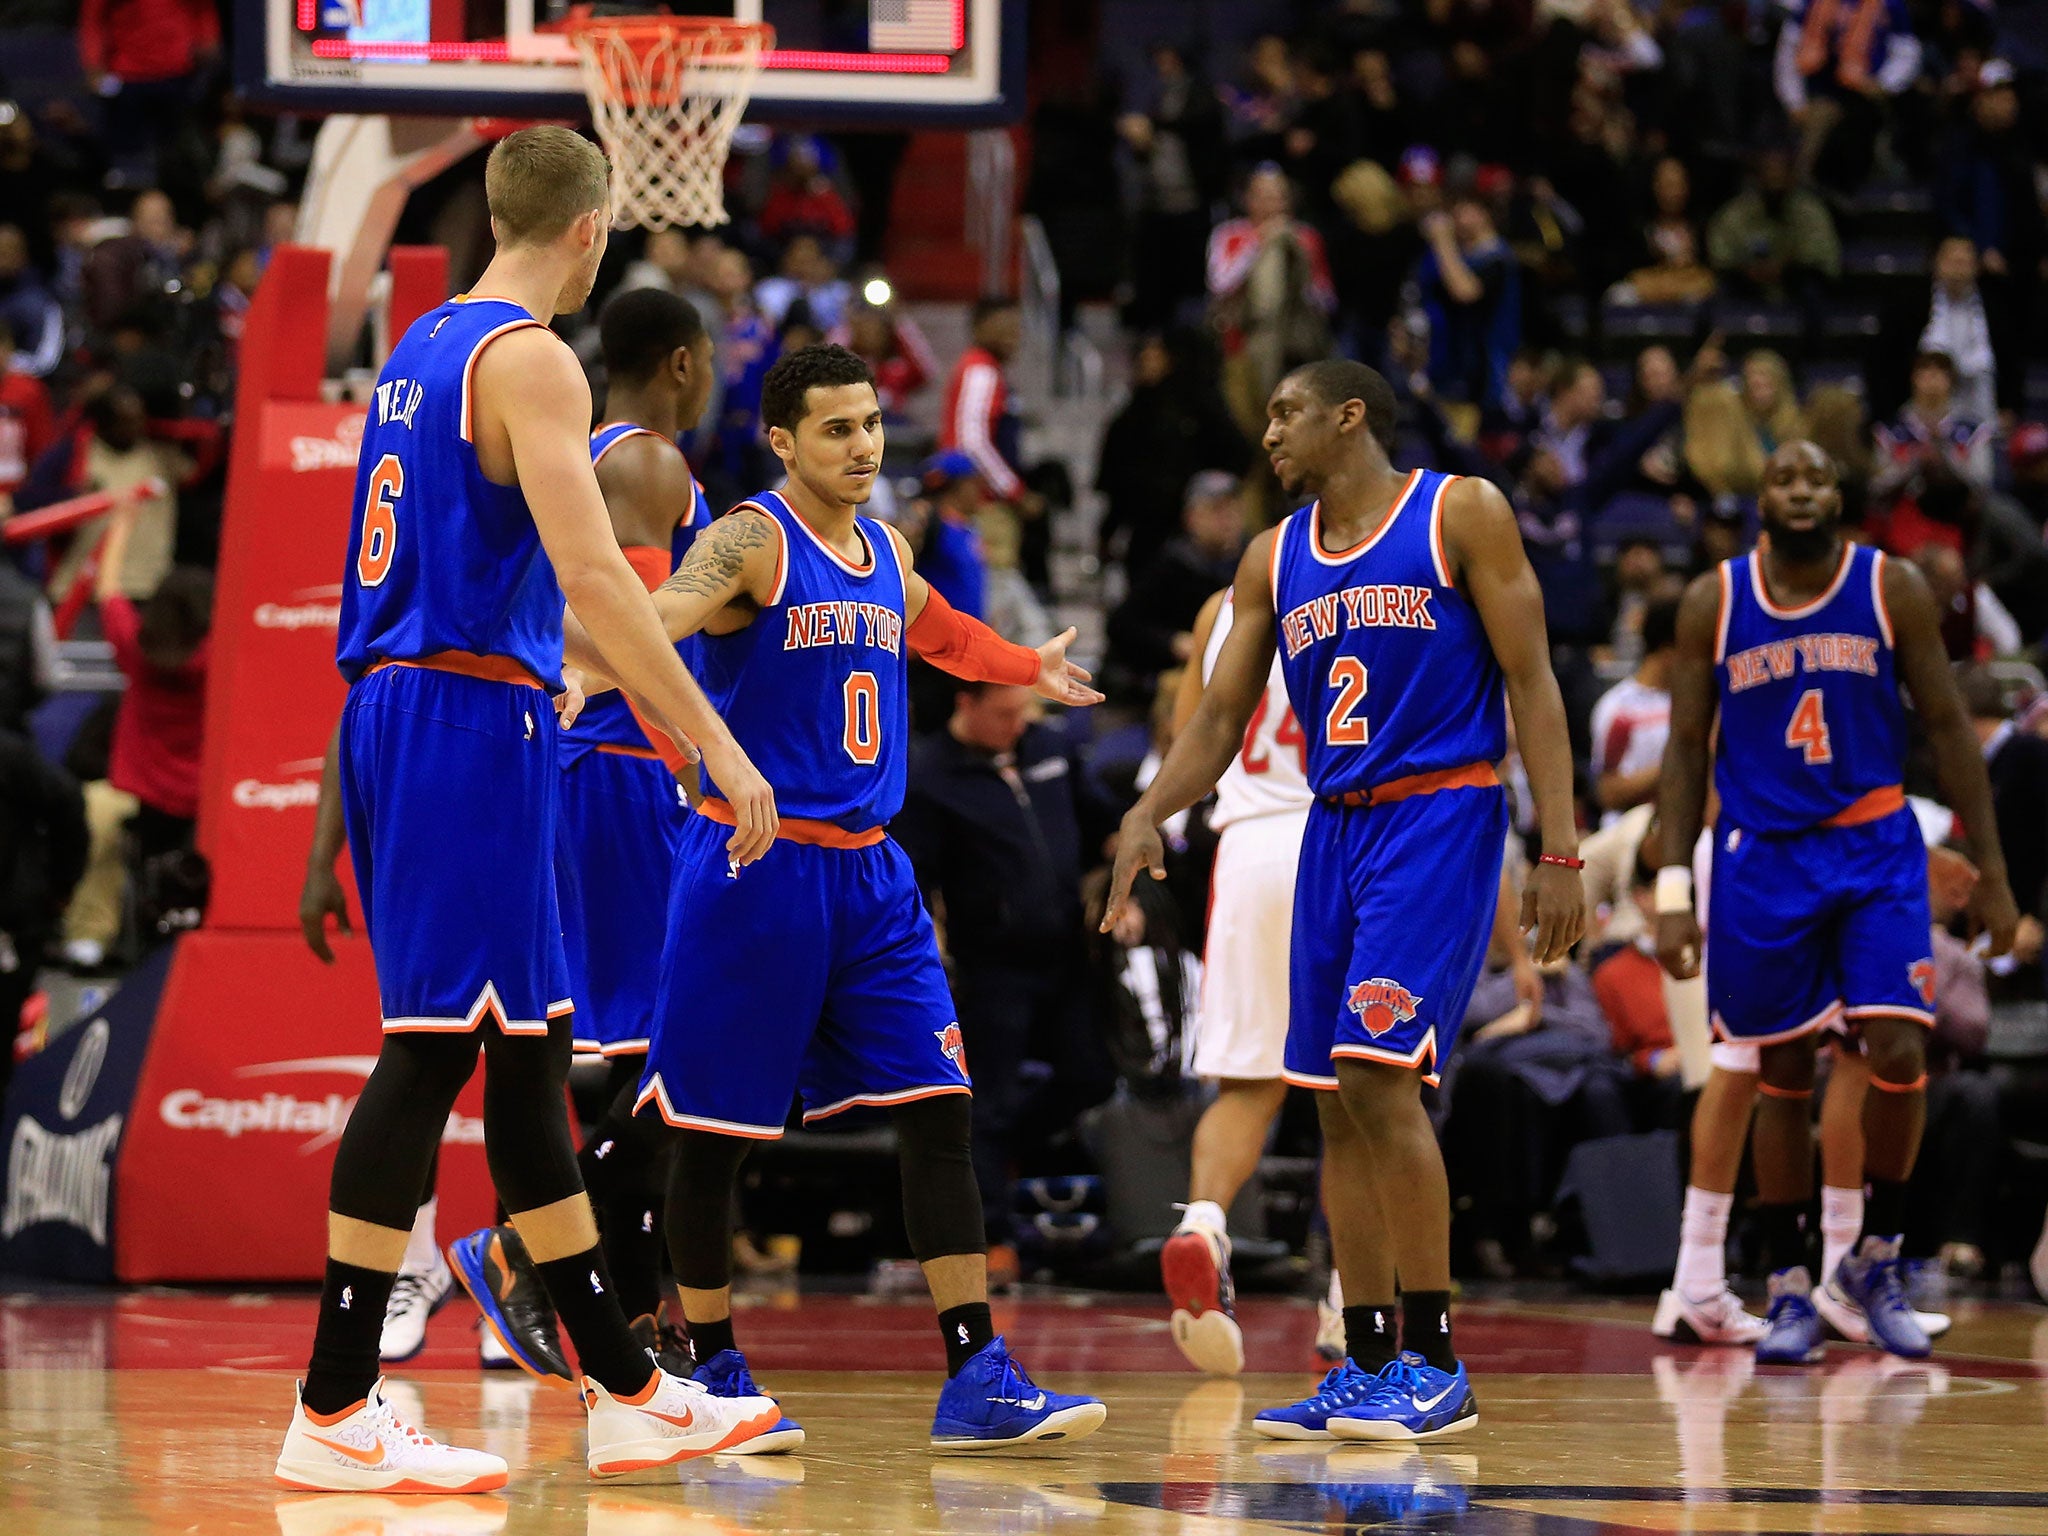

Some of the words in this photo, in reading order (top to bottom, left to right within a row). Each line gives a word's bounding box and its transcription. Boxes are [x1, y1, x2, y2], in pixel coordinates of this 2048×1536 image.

[376, 378, 424, 430] WEAR
[357, 453, 405, 588] 6
[783, 600, 858, 651] NEW
[1281, 593, 1339, 661] NEW
[1340, 584, 1437, 631] YORK
[1326, 655, 1369, 747] 2
[1725, 637, 1796, 694] NEW
[1795, 633, 1880, 677] YORK
[843, 670, 882, 765] 0
[1785, 687, 1833, 765] 4
[159, 1088, 344, 1138] Capital
